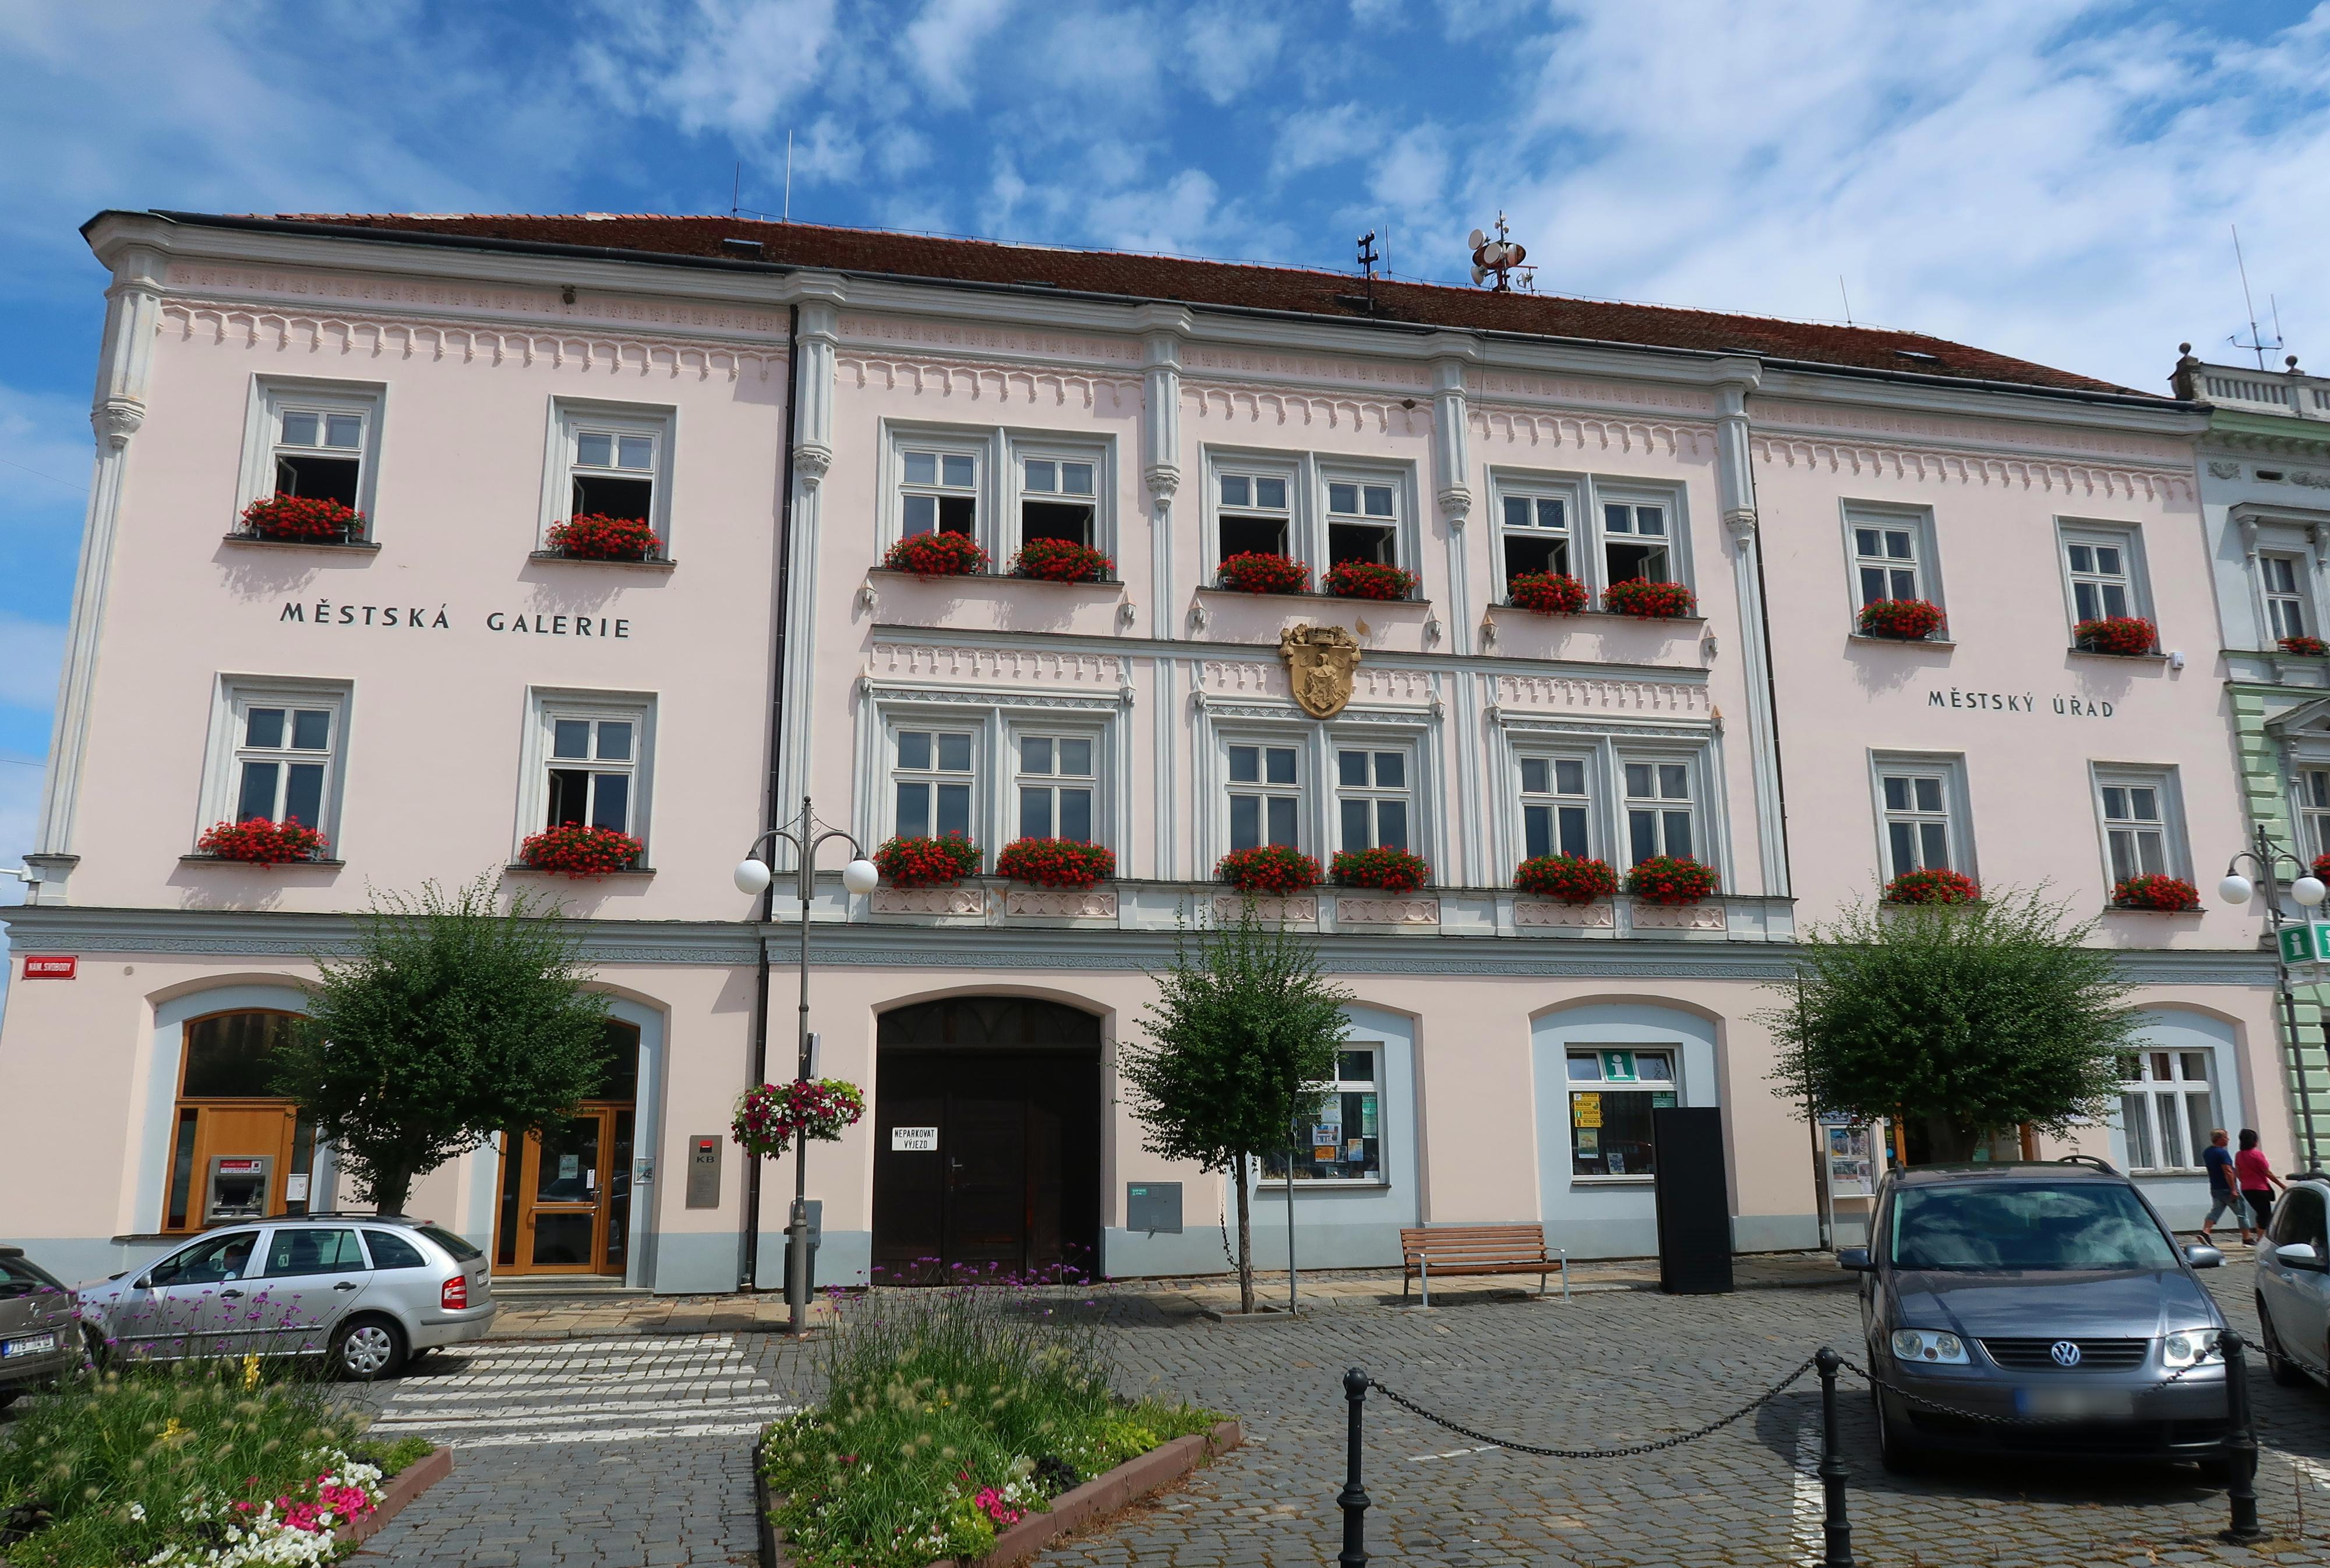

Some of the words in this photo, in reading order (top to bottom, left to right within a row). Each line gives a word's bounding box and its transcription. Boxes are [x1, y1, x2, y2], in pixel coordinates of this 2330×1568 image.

[280, 598, 449, 629] MĚSTSKÁ
[486, 612, 630, 638] GALERIE
[1927, 687, 2034, 712] MĚSTSKÝ
[2052, 693, 2113, 718] ÚŘAD
[894, 1129, 935, 1138] NEPARKOVAT
[904, 1138, 927, 1149] VÝJEZD
